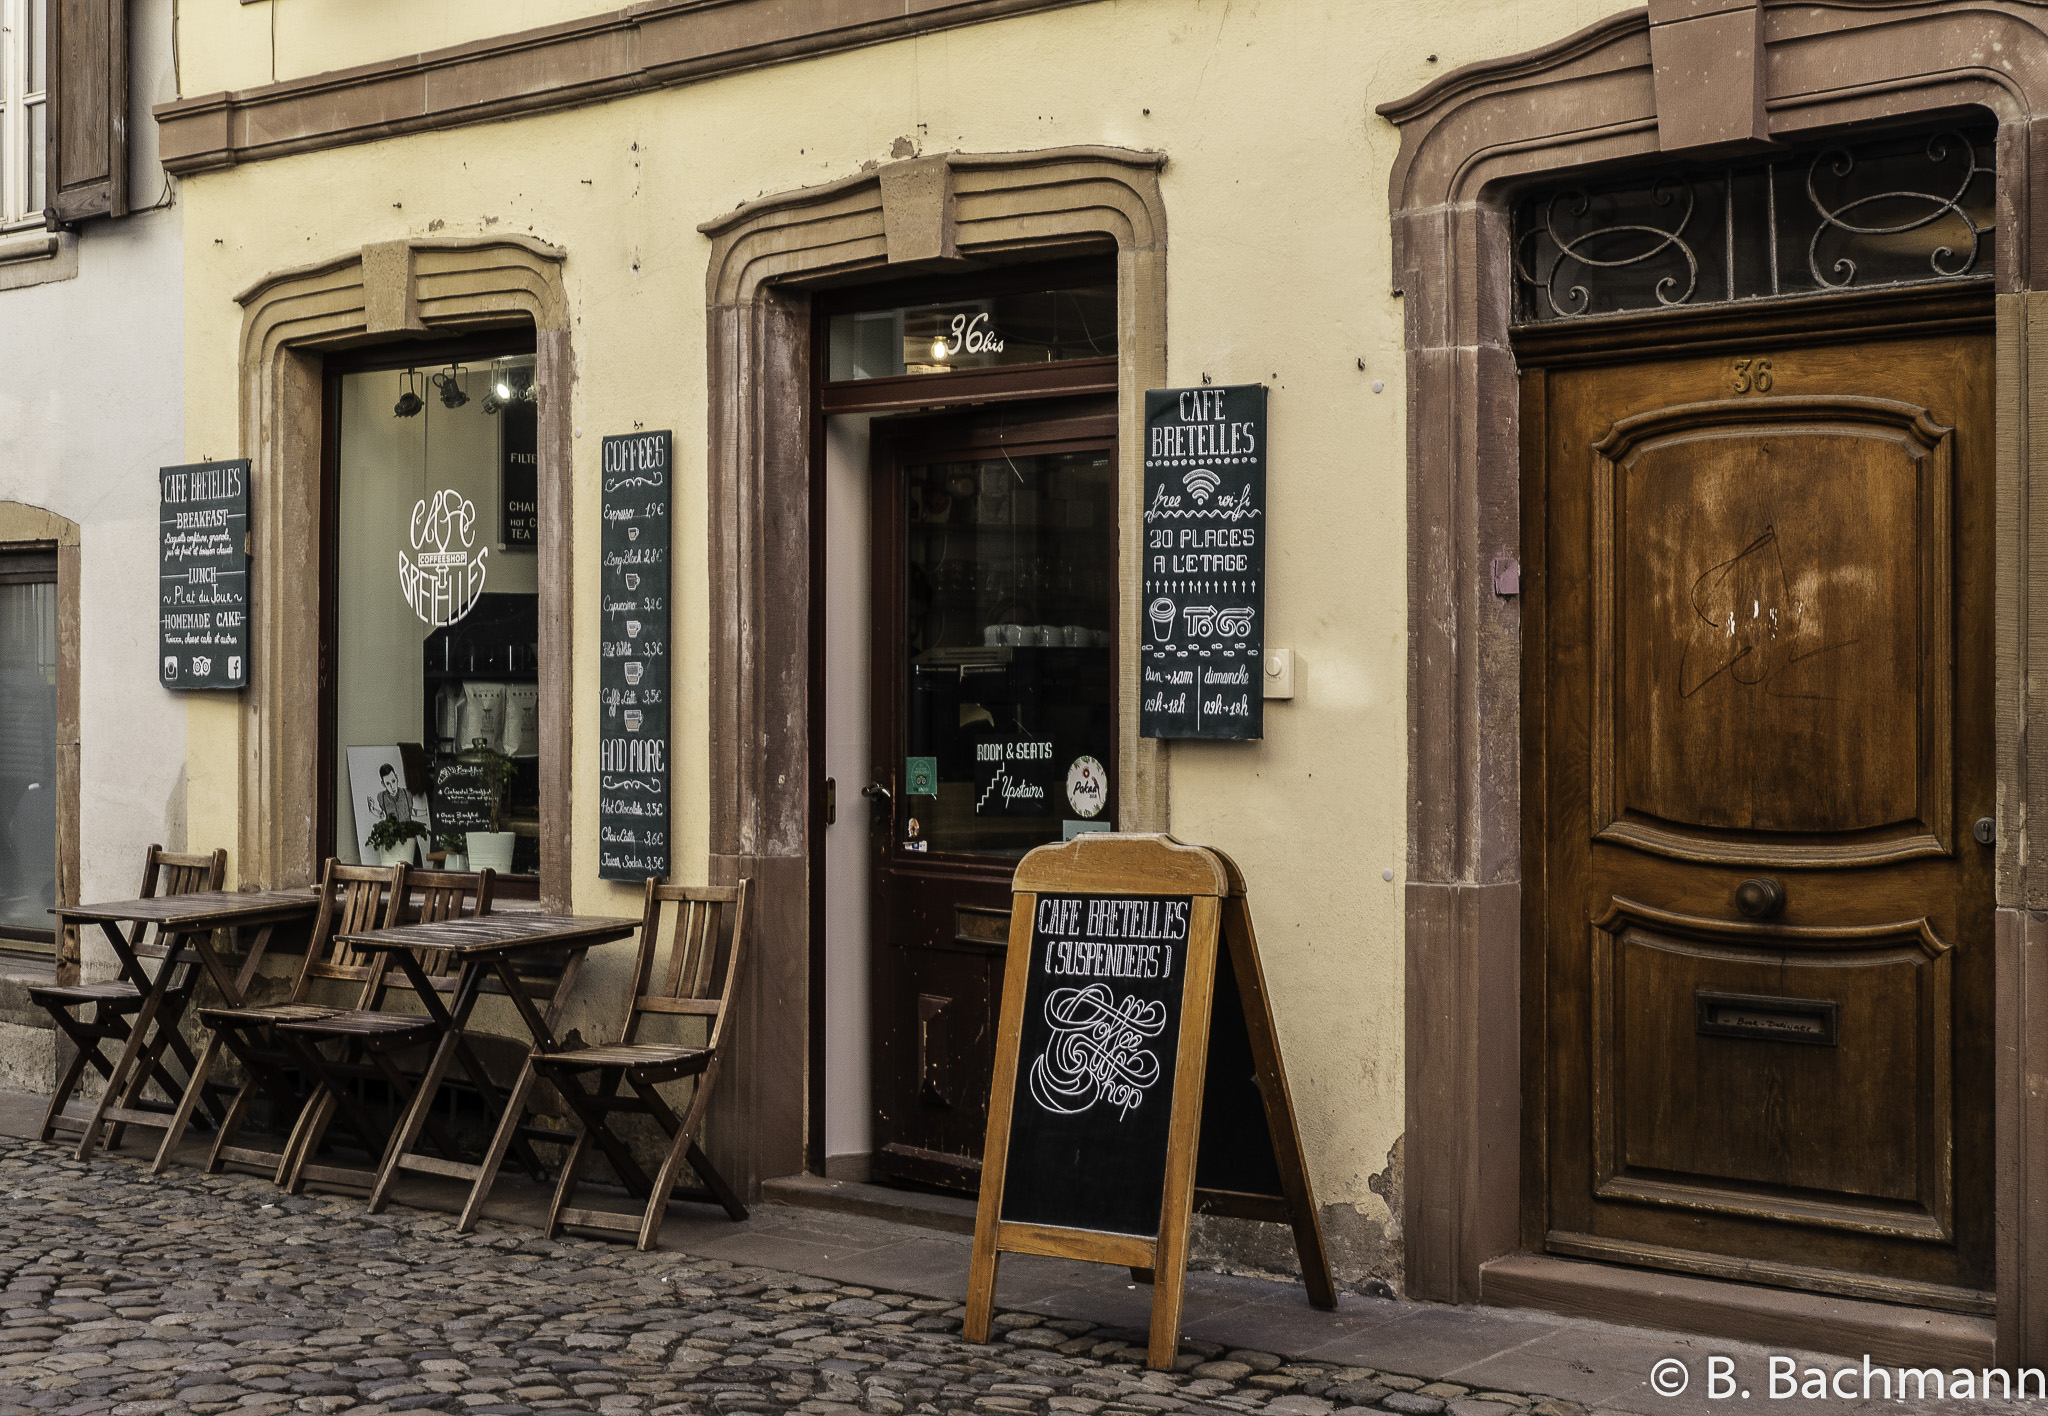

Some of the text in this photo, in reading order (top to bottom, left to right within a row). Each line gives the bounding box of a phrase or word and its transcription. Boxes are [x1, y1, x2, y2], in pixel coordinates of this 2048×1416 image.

[1734, 358, 1773, 393] 36
[1179, 390, 1226, 422] CAFE
[1152, 422, 1255, 457] BRETELLES
[605, 436, 664, 472] COFFEES
[164, 468, 241, 503] CAFE BRETELLES
[1148, 483, 1181, 523] free
[176, 508, 229, 529] BREAKFAST
[603, 502, 665, 530] Espresso 1,9€
[512, 528, 531, 539] TEA
[1150, 528, 1255, 549] 20 PLACES
[419, 553, 467, 565] COFFEESHOP
[1153, 554, 1248, 573] A L'ETAGE
[188, 567, 217, 584] LUNCH
[198, 589, 210, 603] du
[399, 546, 488, 627] BRETELLES
[164, 611, 241, 630] HOMEMADE CAKE
[1169, 669, 1194, 685] sam
[1203, 664, 1250, 685] dimanche
[601, 738, 665, 773] AND MORE
[976, 741, 1053, 761] ROOM & SEATS
[601, 797, 614, 814] Hot
[614, 799, 643, 815] Chocolate
[601, 825, 616, 842] Chai
[1038, 899, 1189, 939] CAFE BRETELLES
